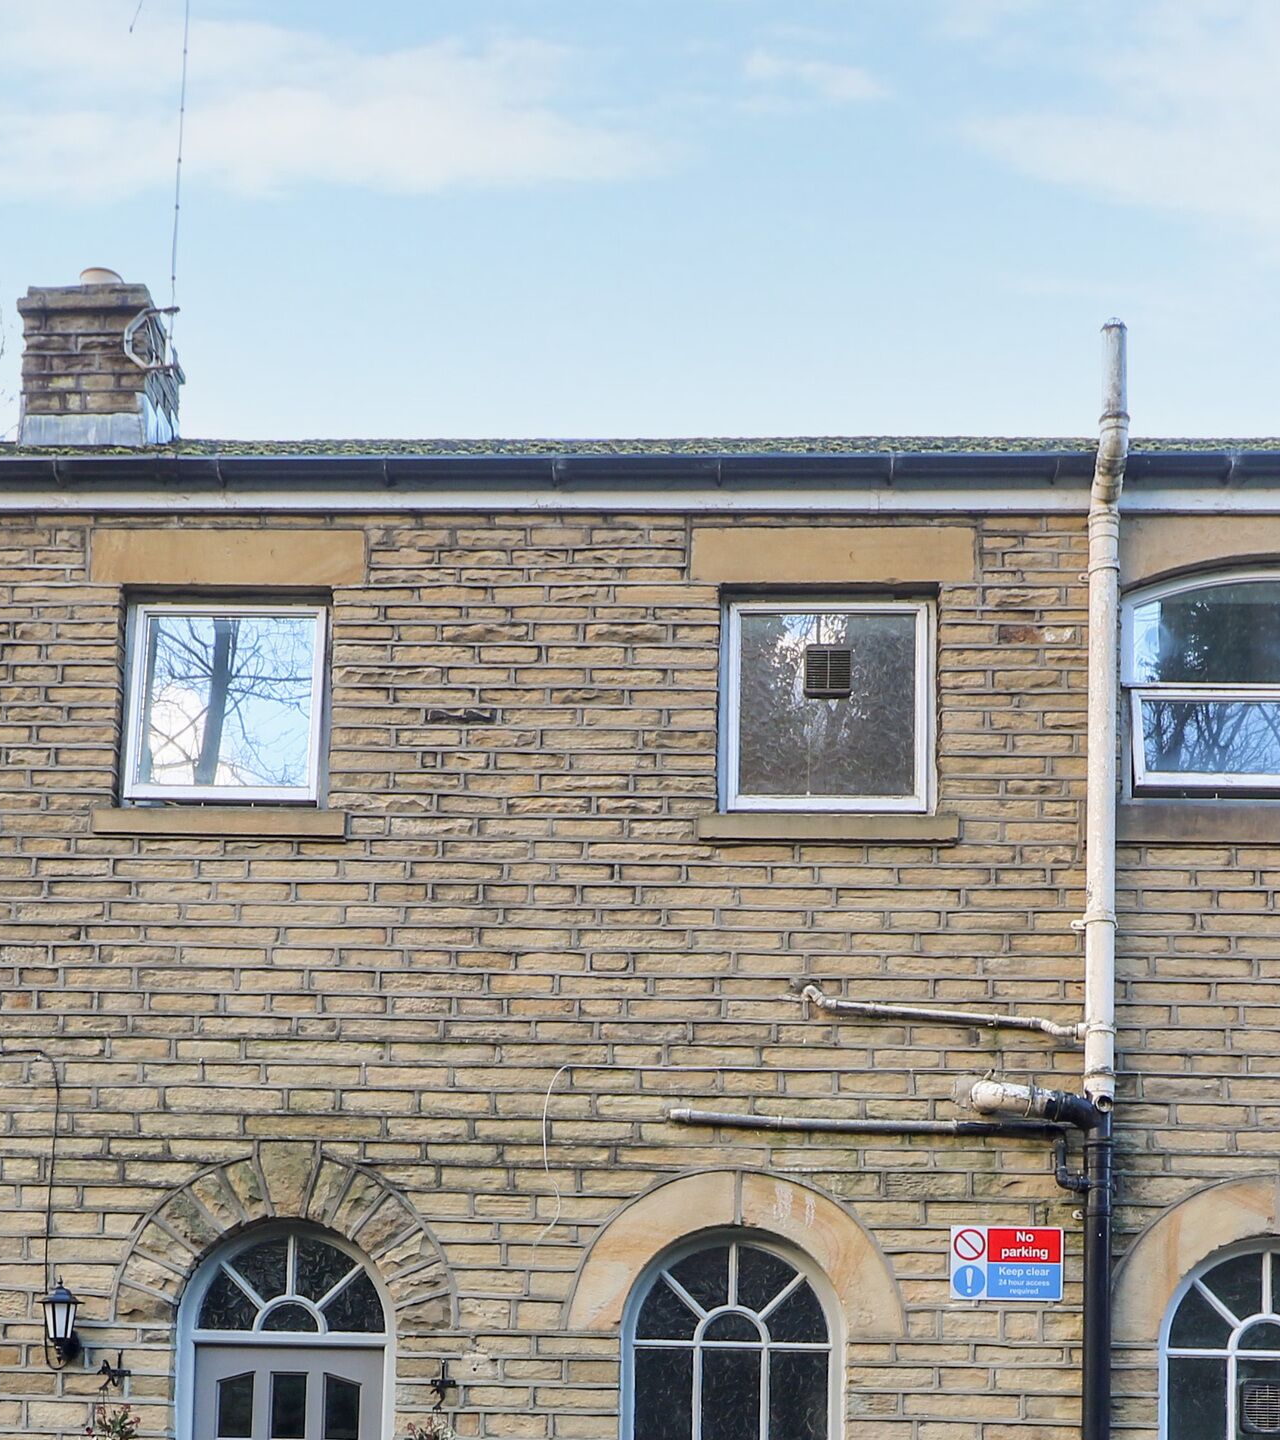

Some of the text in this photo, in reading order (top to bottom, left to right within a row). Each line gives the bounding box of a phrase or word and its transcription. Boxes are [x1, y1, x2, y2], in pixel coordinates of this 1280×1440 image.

[1016, 1231, 1034, 1242] No
[1001, 1246, 1049, 1260] parking
[999, 1267, 1050, 1277] Keep clear
